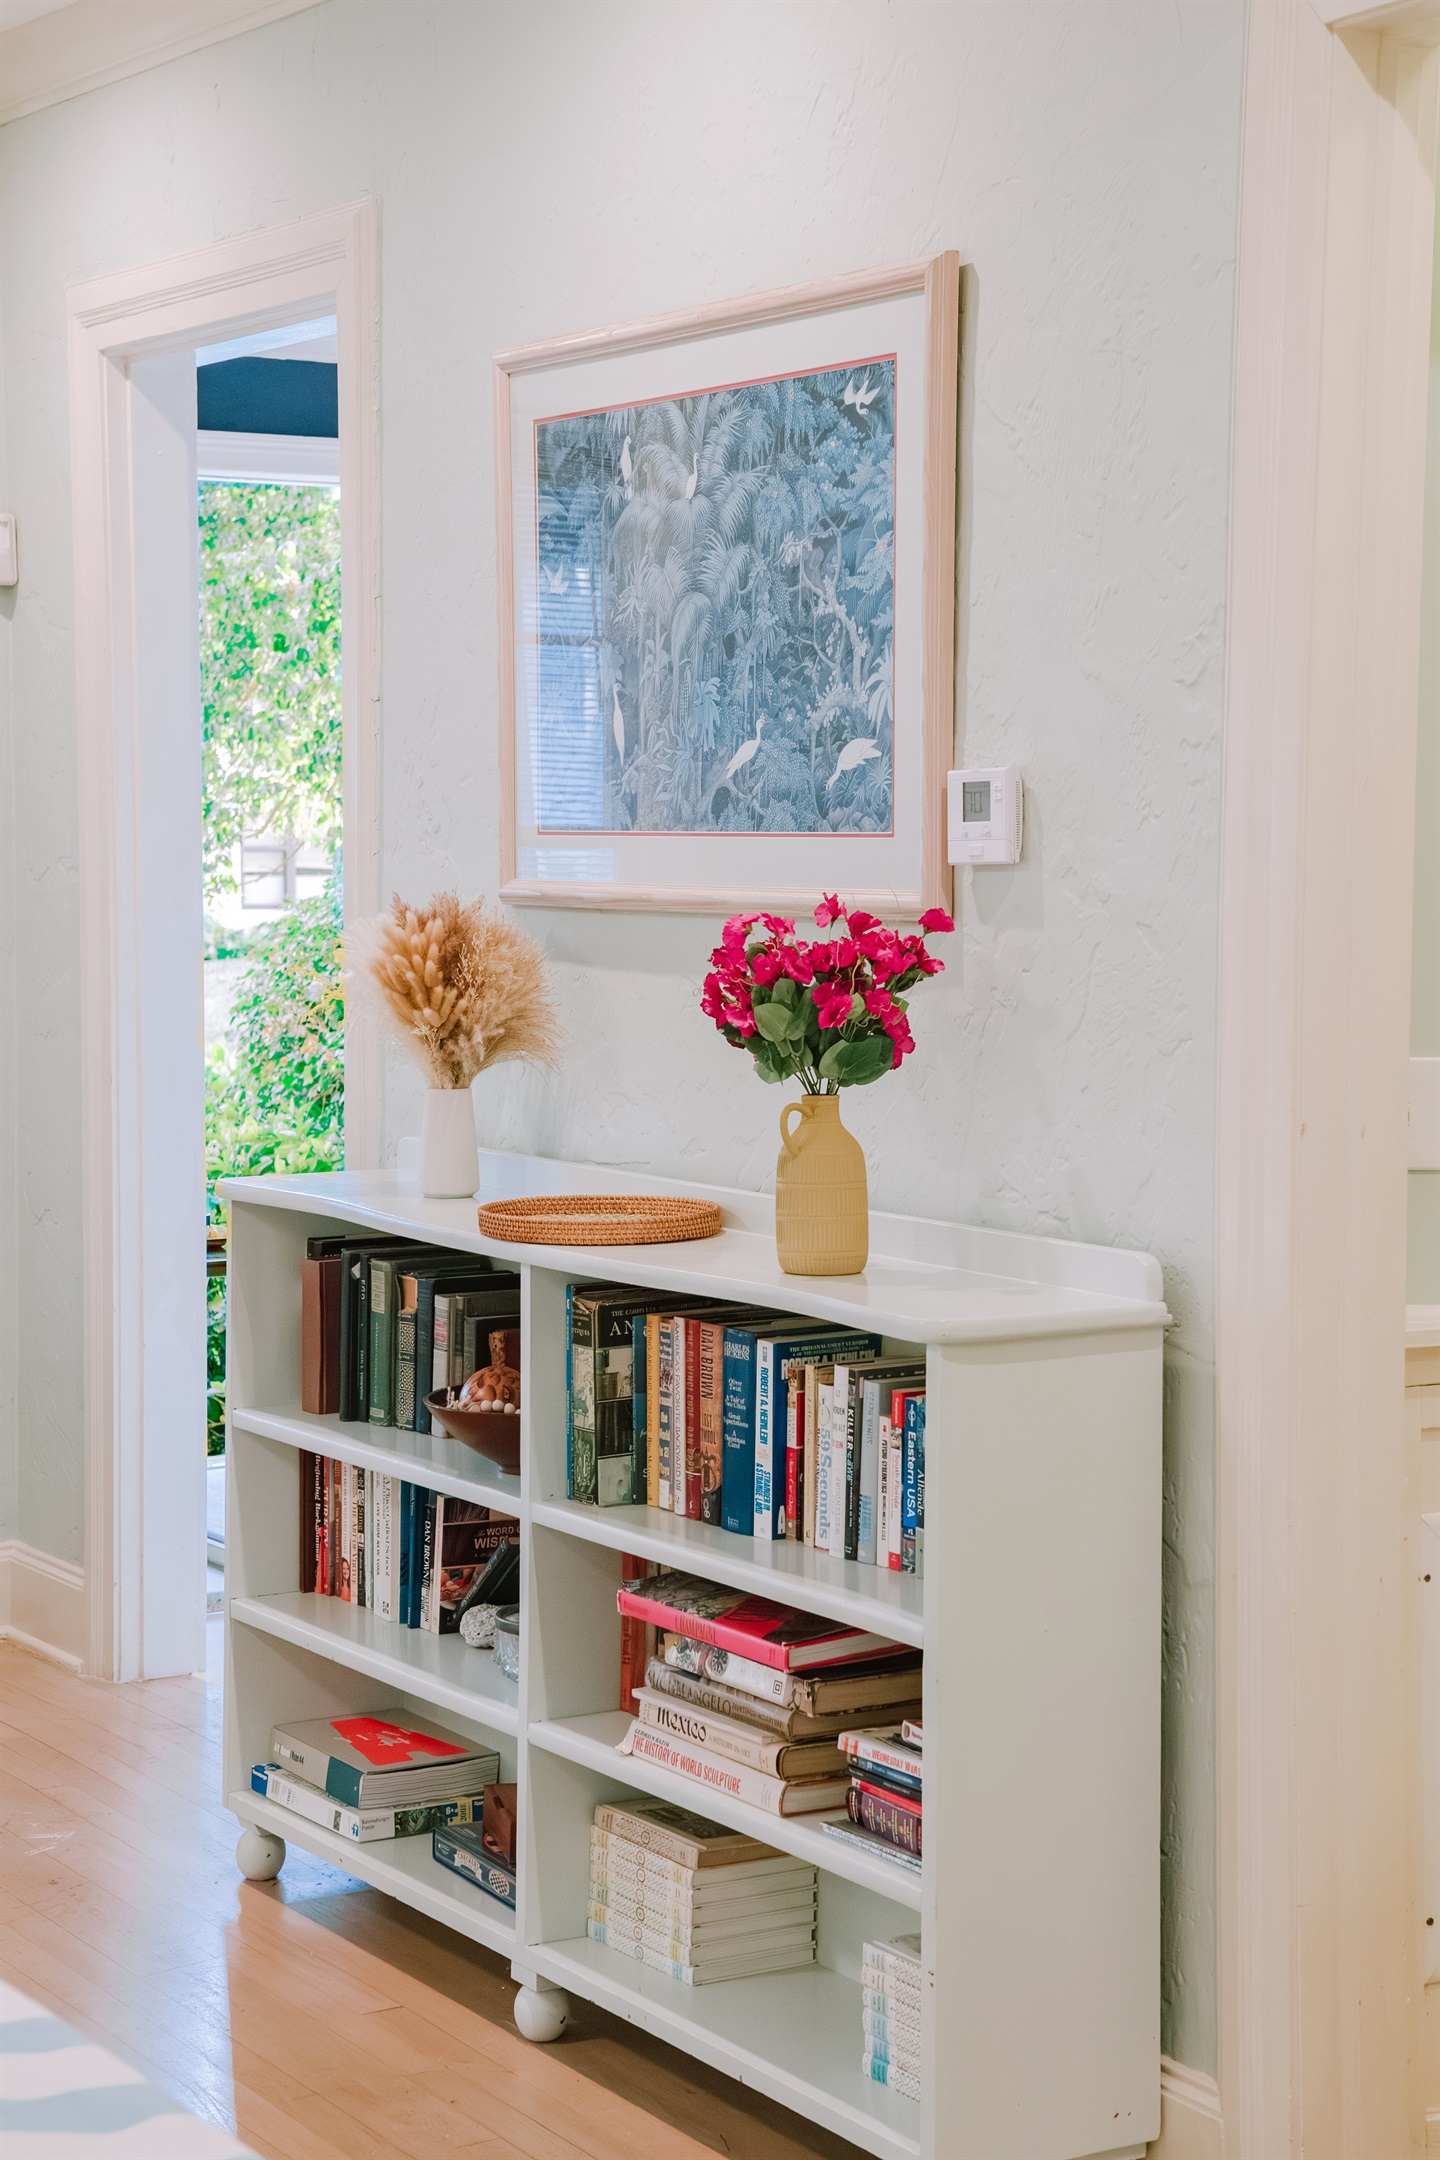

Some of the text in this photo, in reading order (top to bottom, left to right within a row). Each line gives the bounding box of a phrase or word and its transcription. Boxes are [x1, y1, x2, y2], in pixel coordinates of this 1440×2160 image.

[611, 1309, 624, 1317] THE
[687, 1350, 694, 1362] DA
[724, 1340, 750, 1352] CHARLES
[724, 1348, 750, 1361] DICKENS
[701, 1329, 714, 1400] DAN BROWN
[728, 1378, 742, 1388] Oliver
[759, 1366, 769, 1399] ROBERT
[759, 1408, 769, 1446] HEINLEIN
[847, 1408, 855, 1450] KILLER
[907, 1430, 917, 1487] Eastern
[755, 1468, 764, 1497] STRANGE
[763, 1470, 771, 1502] STRANGER
[819, 1427, 831, 1539] 59 Seconds
[917, 1469, 925, 1516] Allende
[755, 1497, 763, 1514] LAND
[907, 1488, 917, 1518] USA
[351, 1538, 358, 1551] OF
[487, 1526, 514, 1536] WORD
[423, 1544, 431, 1579] BROWN
[647, 1670, 732, 1716] MICHELANGELO
[634, 1728, 655, 1741] GERMAIN
[713, 1736, 733, 1751] HISTORY
[632, 1734, 742, 1795] THE HISTORY OF WORLD SCULPTURE
[872, 1748, 904, 1769] WEDNESDAY
